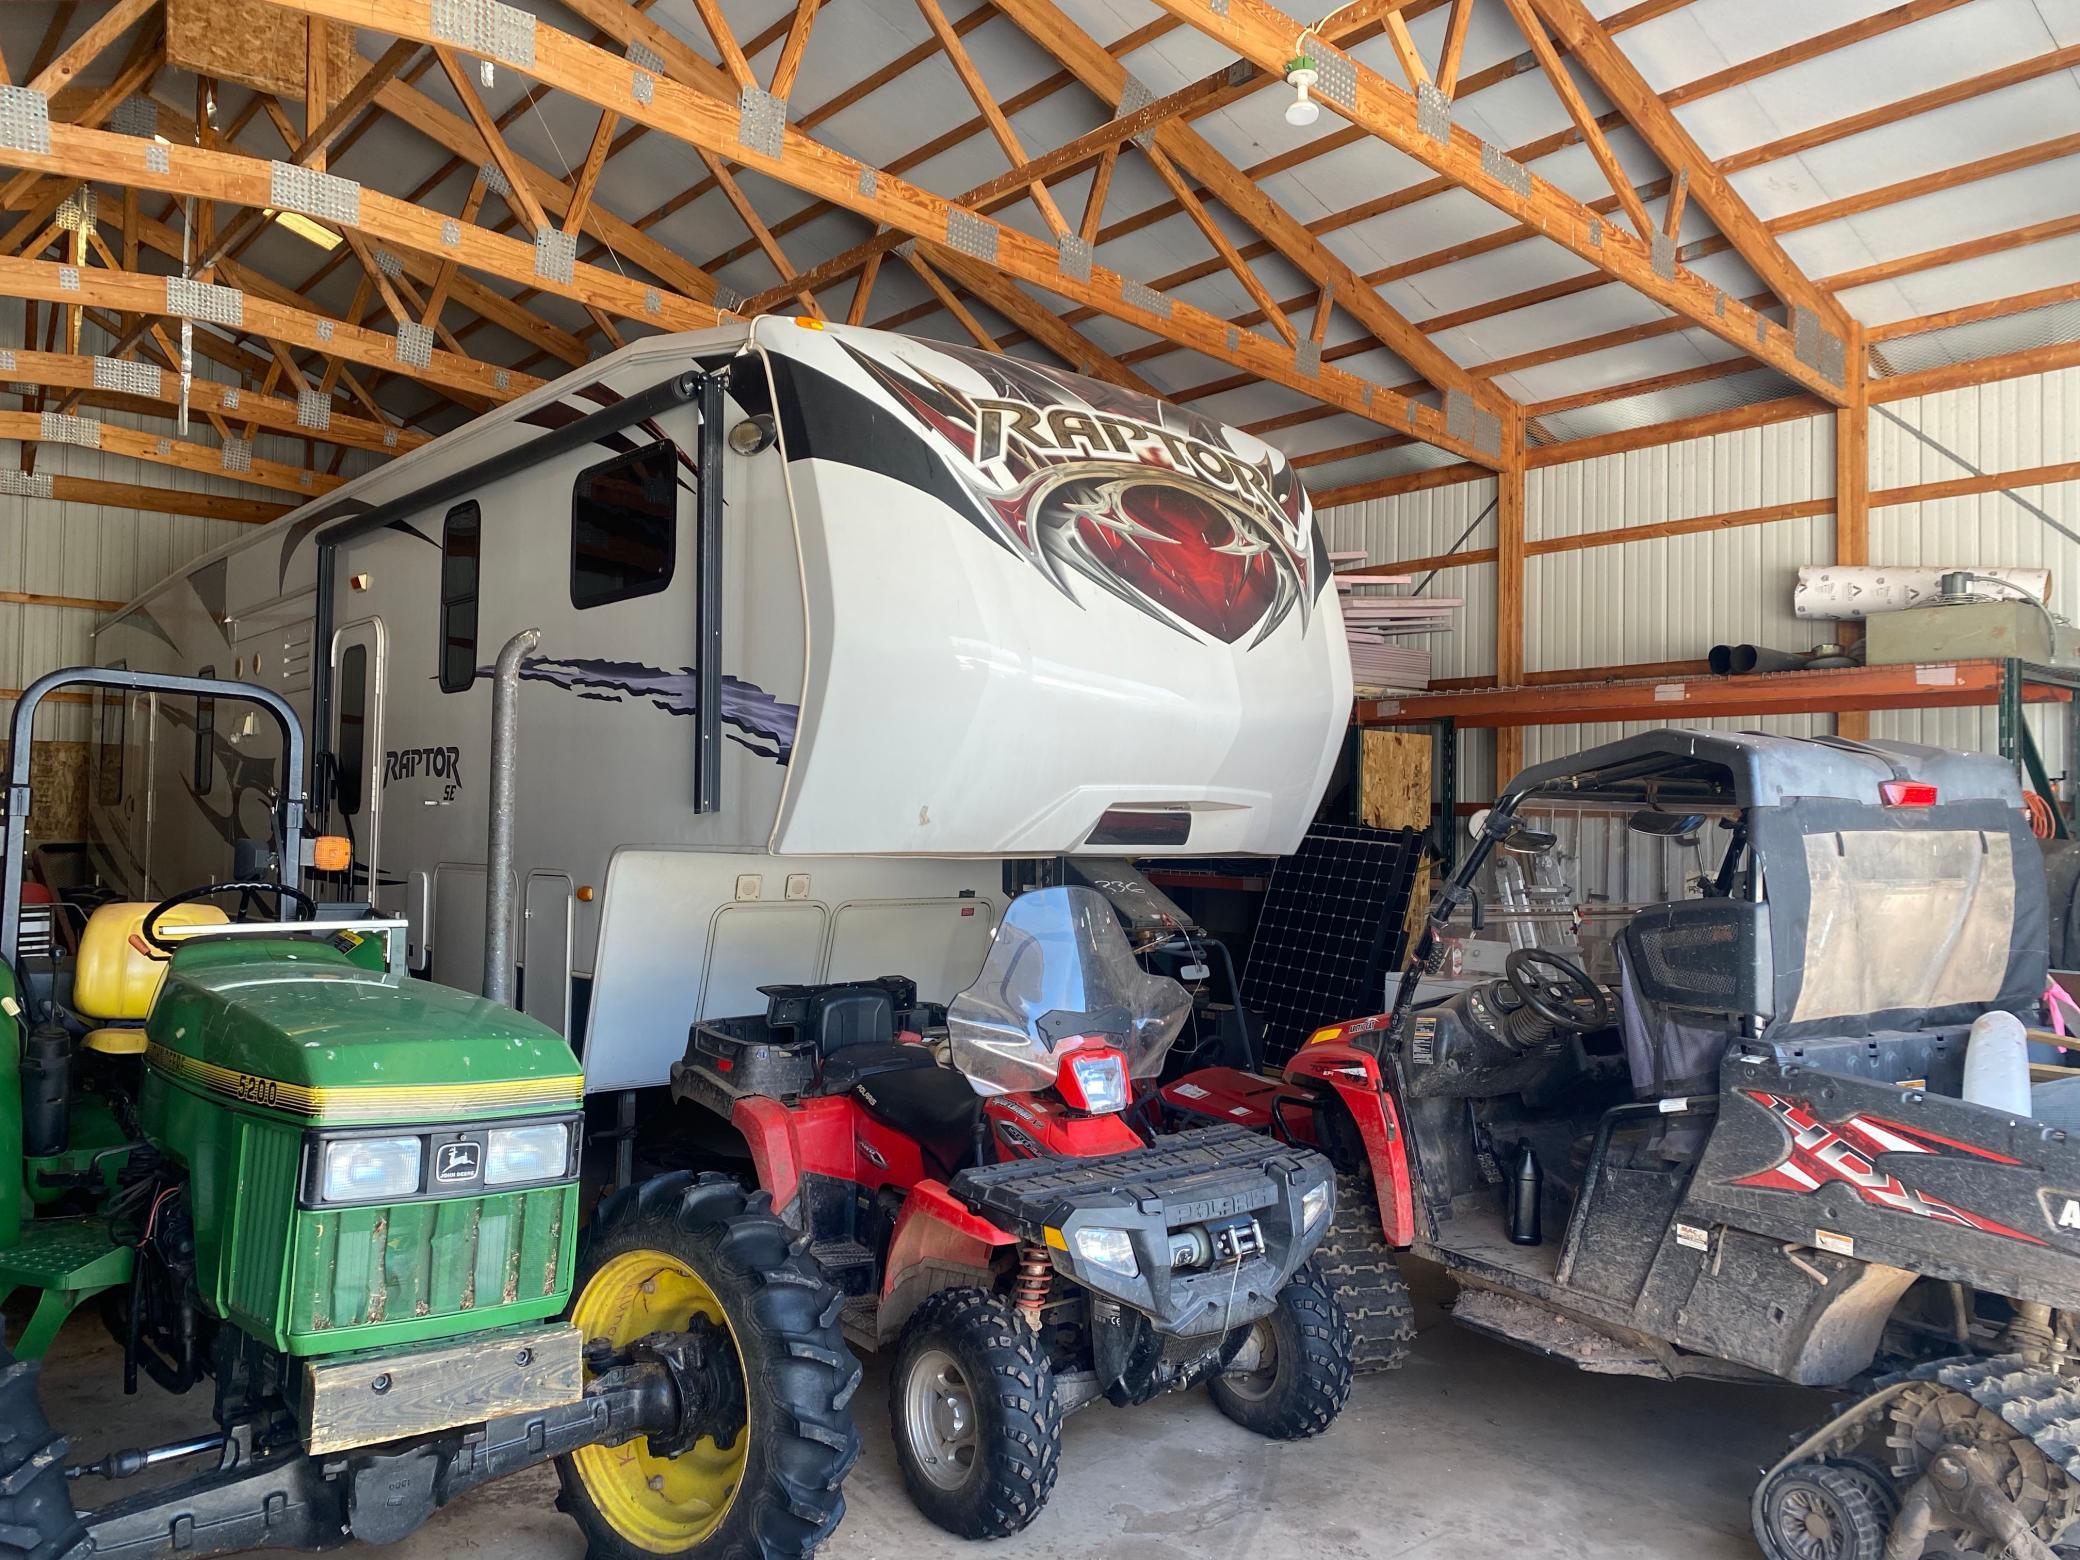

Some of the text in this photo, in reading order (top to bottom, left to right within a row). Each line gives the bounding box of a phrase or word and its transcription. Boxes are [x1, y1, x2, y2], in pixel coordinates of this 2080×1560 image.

[970, 398, 1290, 525] RAPTOR
[383, 746, 462, 790] RAPTOR
[443, 785, 457, 801] SE
[237, 1074, 278, 1106] 5200
[856, 1083, 878, 1107] POLARIS
[1177, 1188, 1267, 1223] POLARIS
